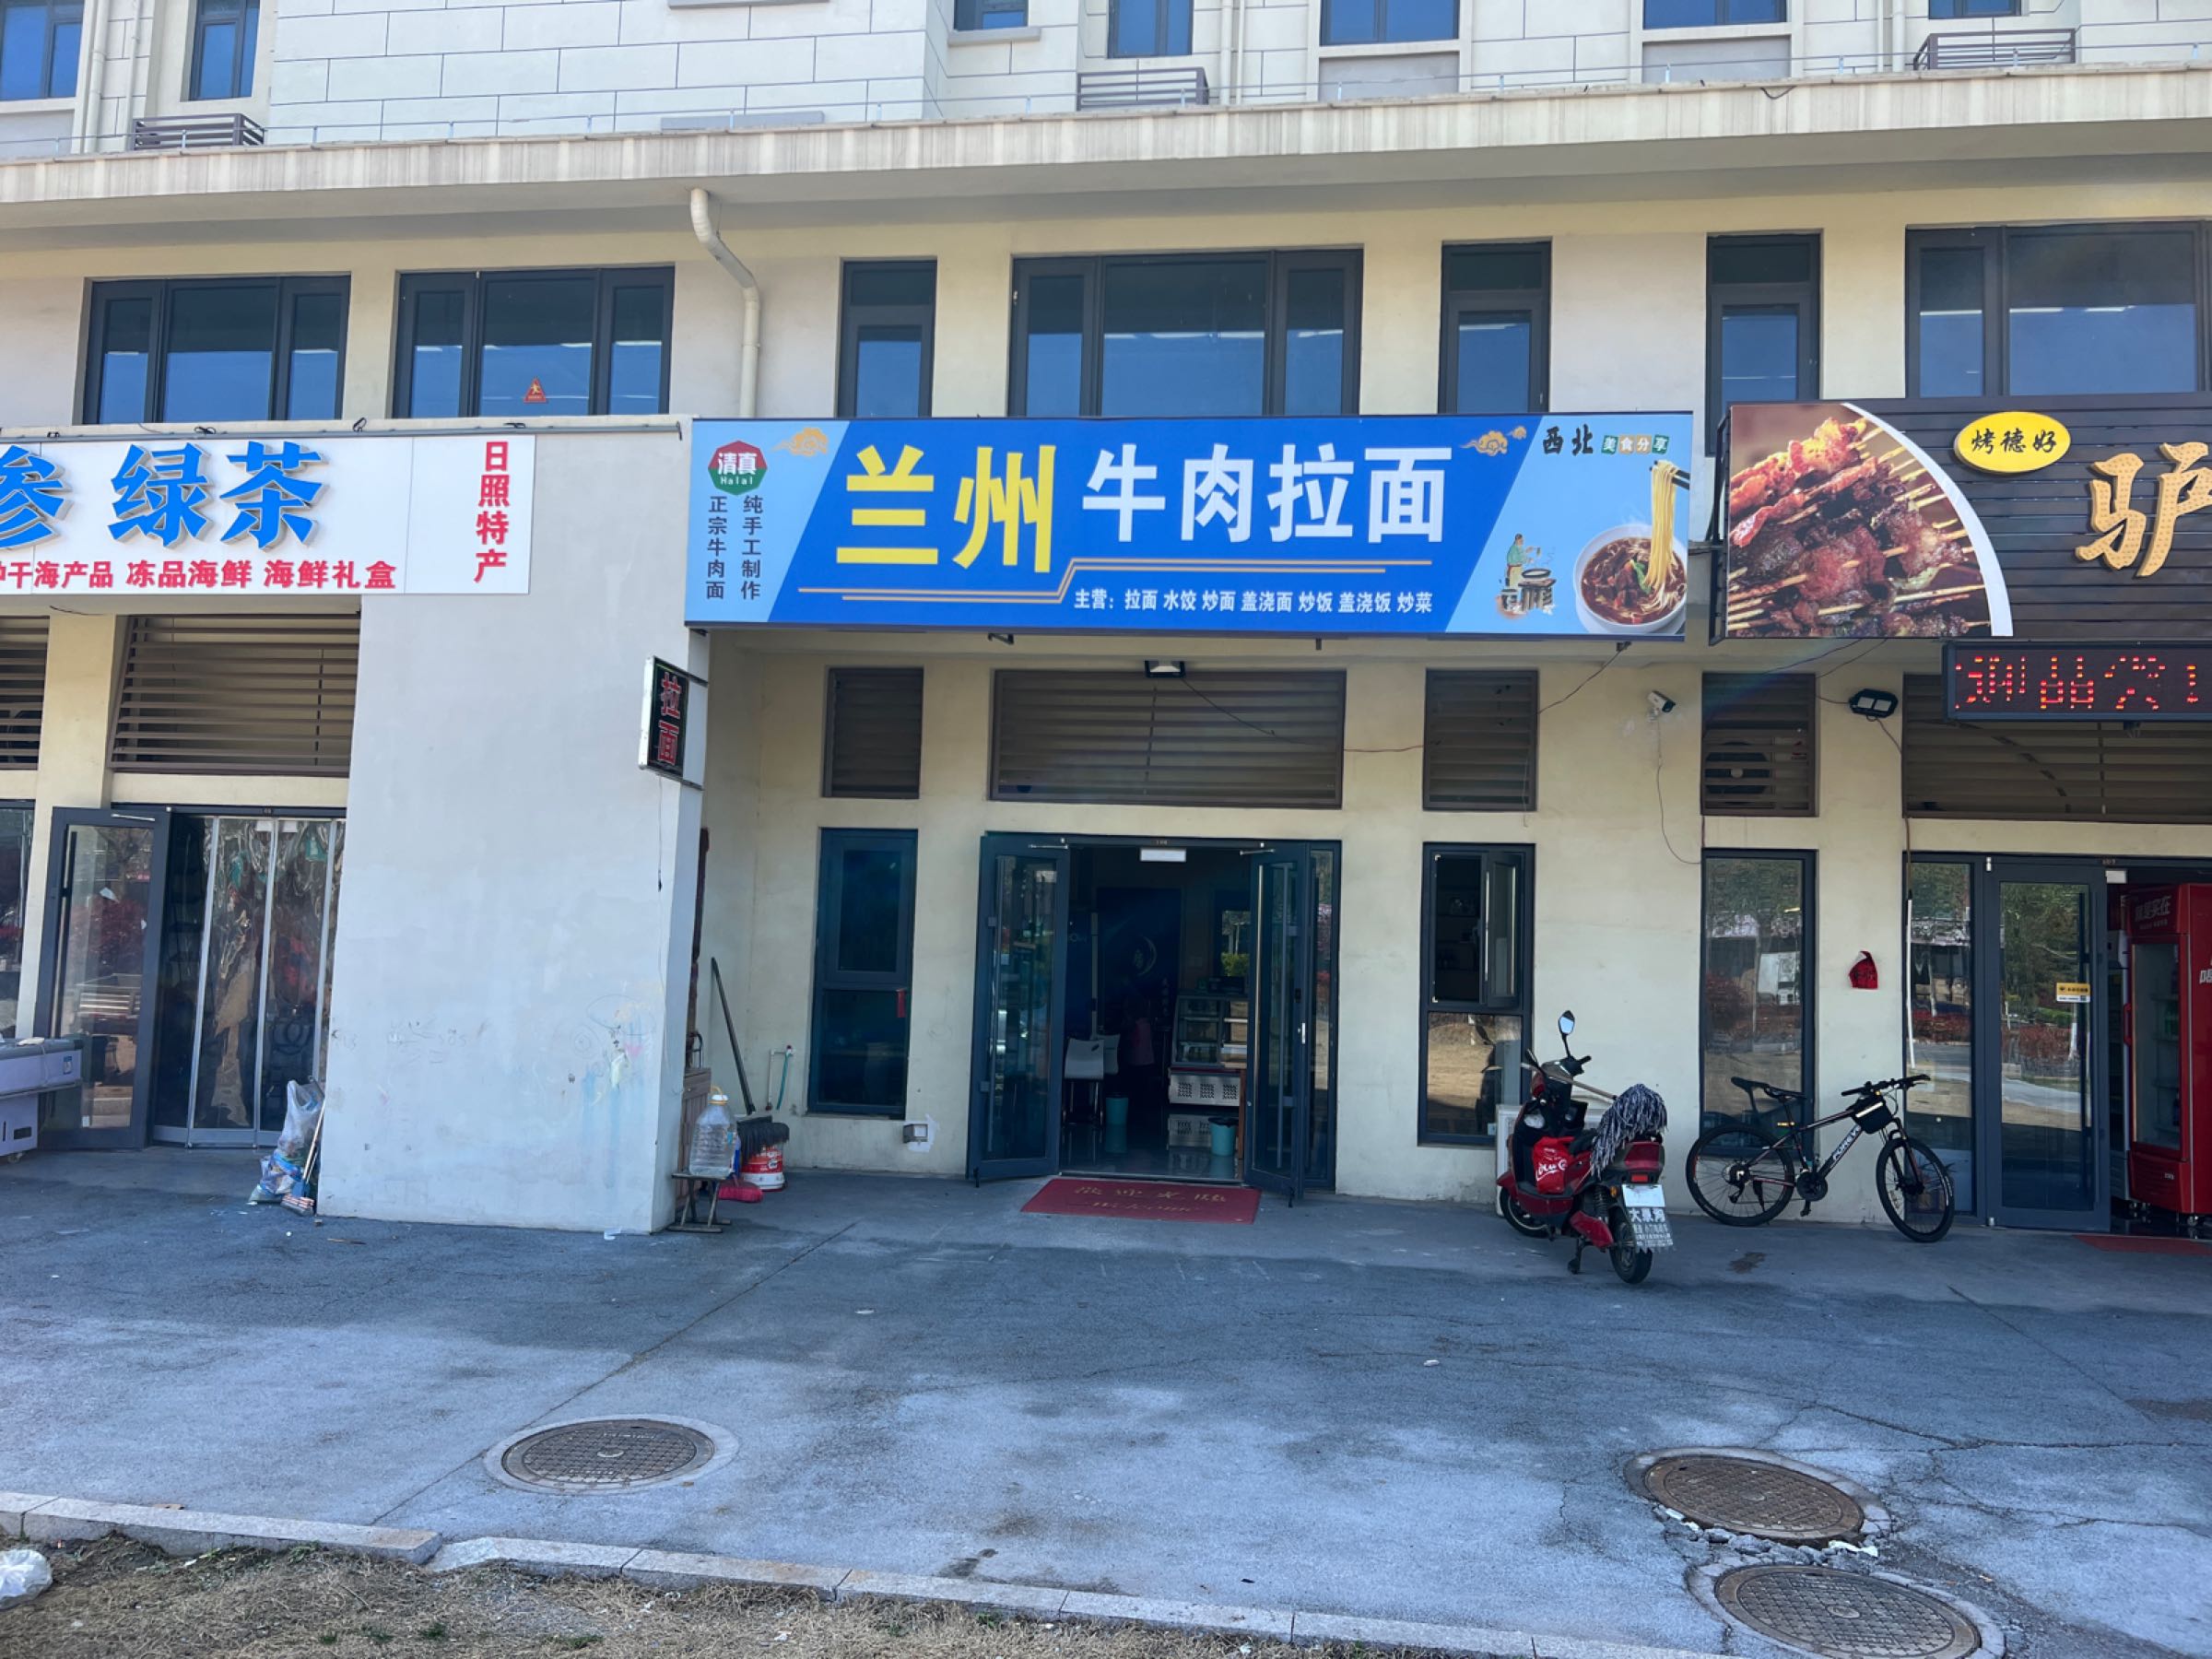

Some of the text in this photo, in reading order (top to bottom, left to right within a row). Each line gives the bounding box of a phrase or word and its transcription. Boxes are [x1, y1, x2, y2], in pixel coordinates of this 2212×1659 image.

[1542, 423, 1594, 456] 西北
[1603, 435, 1668, 453] 美食分享
[1971, 428, 2057, 454] 烤德好
[717, 452, 758, 476] 清真
[108, 441, 328, 551] 绿茶
[720, 476, 753, 486] Halal
[474, 441, 511, 583] 日照特产
[835, 442, 1453, 573] 兰州牛肉拉面
[2075, 441, 2212, 578] 驴
[706, 495, 728, 600] 正宗牛肉面
[741, 494, 764, 601] 纯手工制作
[126, 560, 253, 589] 冻品海鲜
[264, 560, 397, 590] 海鲜礼盒
[1124, 589, 1159, 611] 拉面
[1163, 589, 1196, 612] 水饺
[1202, 590, 1236, 612] 炒面
[1241, 591, 1293, 613] 盖浇面
[1298, 591, 1334, 613] 炒饭
[1338, 591, 1392, 614] 盖浇饭
[1396, 592, 1433, 615] 炒菜
